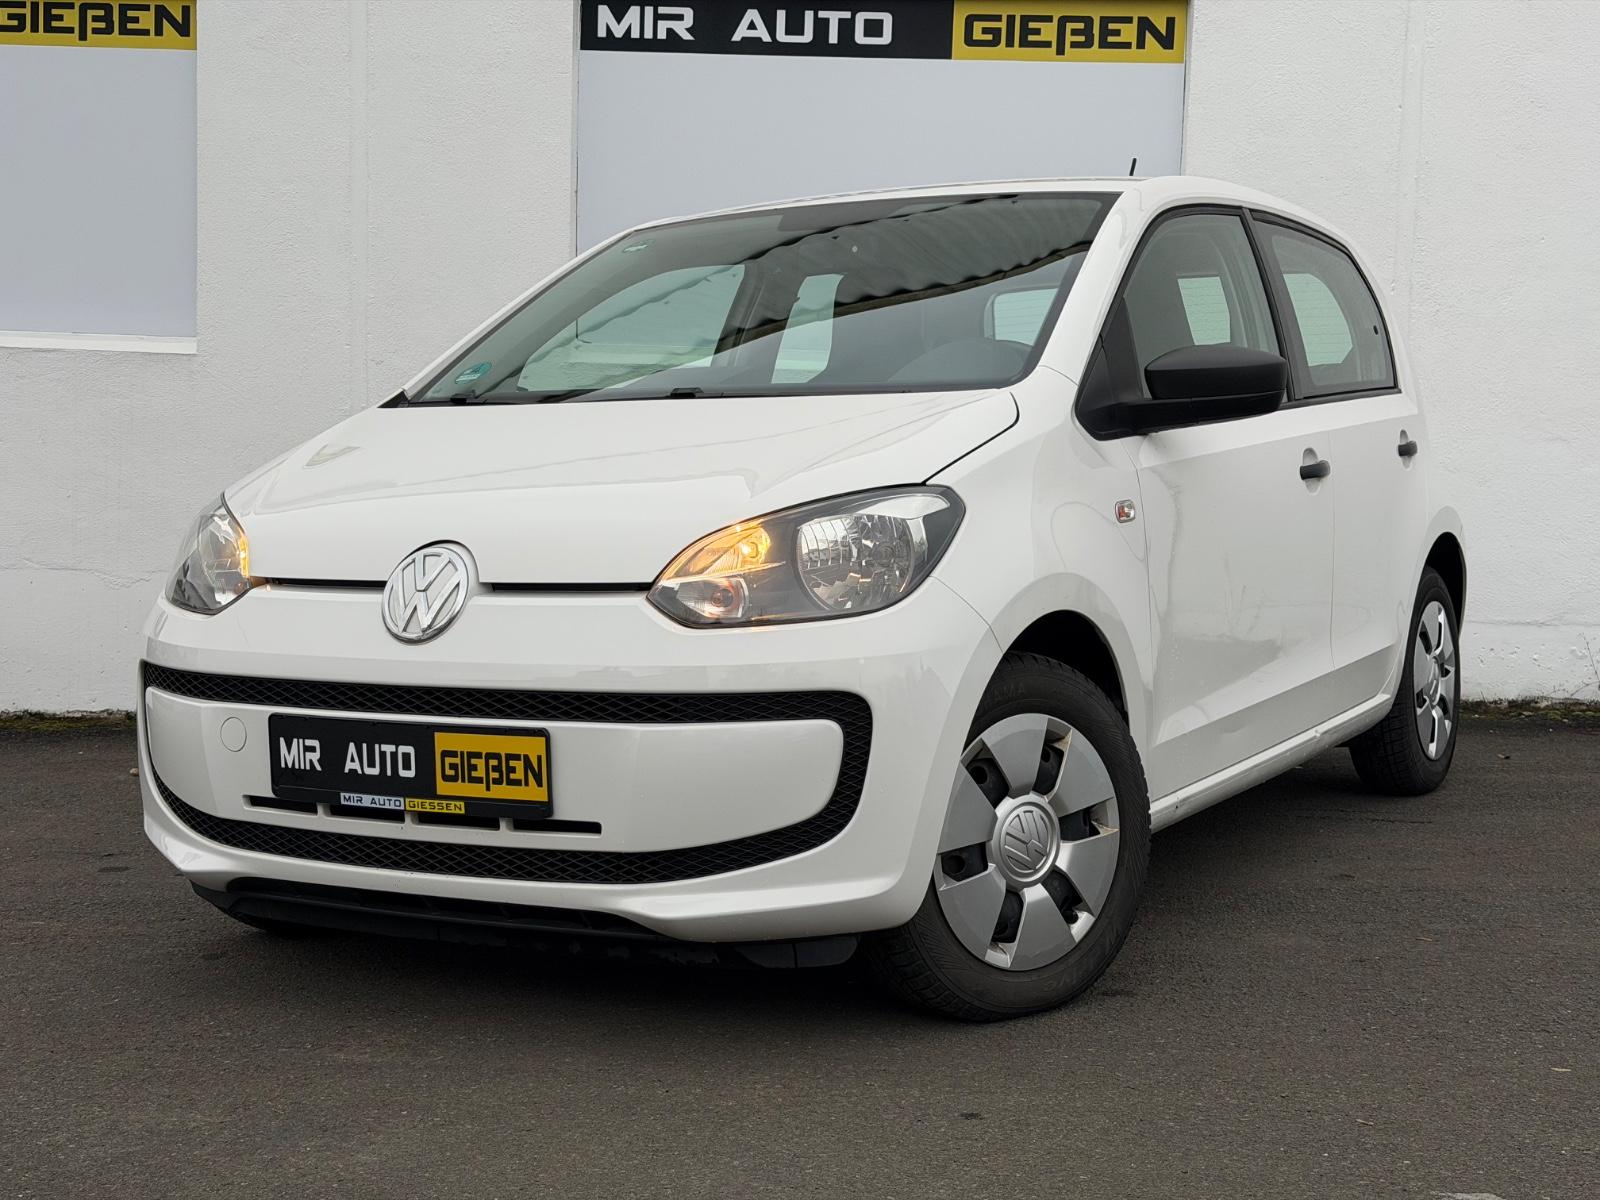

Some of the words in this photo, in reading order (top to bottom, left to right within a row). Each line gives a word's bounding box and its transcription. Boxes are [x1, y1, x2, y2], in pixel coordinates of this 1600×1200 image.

[597, 4, 695, 40] MIR
[730, 8, 893, 45] AUTO
[963, 13, 1176, 56] GIEßEN
[279, 736, 322, 772] MIR
[344, 741, 416, 778] AUTO
[440, 749, 544, 792] GIEßEN
[342, 793, 363, 804] MIR
[370, 796, 402, 808] AUTO
[408, 799, 462, 812] GIESSEN
